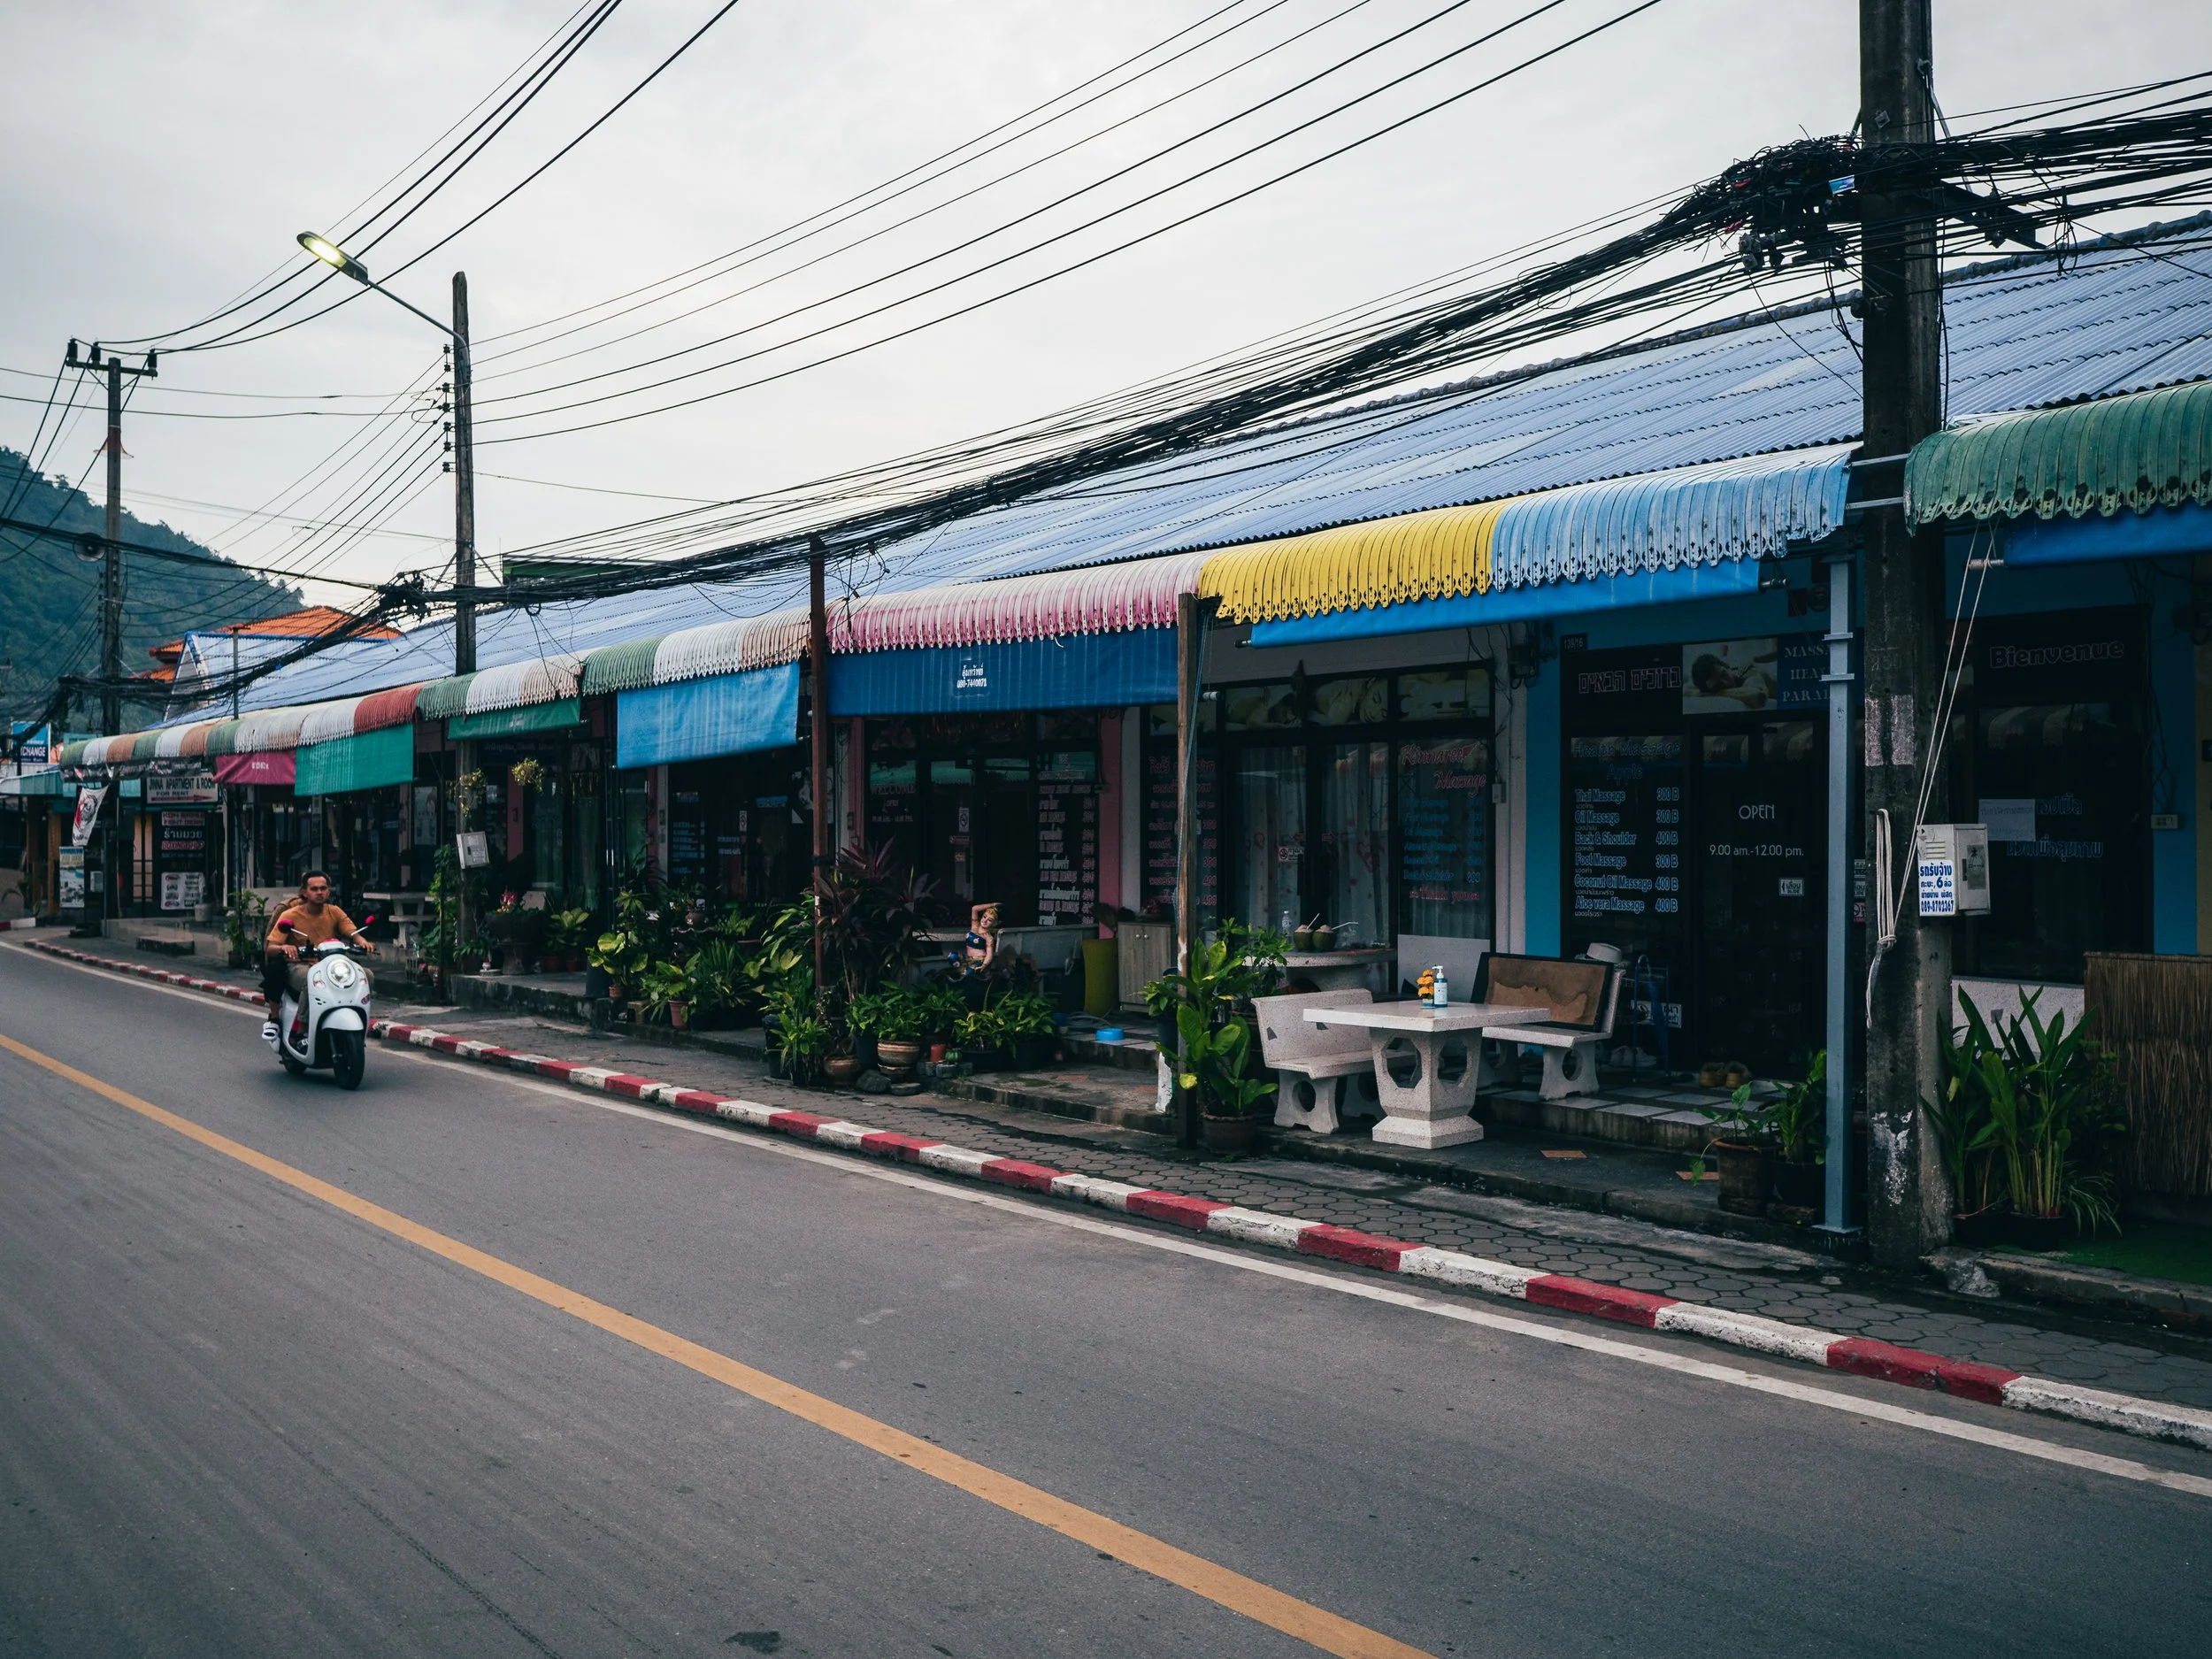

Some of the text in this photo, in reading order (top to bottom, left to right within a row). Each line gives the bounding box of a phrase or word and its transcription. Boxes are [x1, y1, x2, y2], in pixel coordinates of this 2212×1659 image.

[1990, 641, 2124, 669] Bienvenue
[1578, 666, 1681, 694] ברוכים הבאים
[1401, 743, 1466, 766] Kinnaree
[1571, 738, 1684, 759] Health Massage
[1608, 763, 1645, 786] Apple
[150, 778, 163, 790] JINNA
[165, 778, 194, 789] APARTMENT
[196, 778, 202, 789] &
[1435, 771, 1487, 798] Massage
[1575, 788, 1626, 805] Thai Massage
[1655, 787, 1679, 802] 300 B
[1575, 811, 1620, 826] Oil Massage
[1655, 810, 1679, 824] 300 B
[1739, 804, 1775, 819] OPEN
[164, 827, 203, 839] ร้านมวย
[1575, 833, 1637, 846] Back & Shoulder
[1655, 832, 1679, 846] 400 B
[1709, 844, 1732, 856] 9.00
[1786, 846, 1805, 859] pm.
[1575, 853, 1627, 869] Foot Massage
[1655, 854, 1679, 868] 300 B
[1920, 862, 1952, 877] รถรับจ้าง
[1575, 874, 1653, 893] Coconut Oil Massage
[1655, 877, 1679, 891] 400 B
[1936, 877, 1943, 888] 6
[1575, 896, 1646, 915] Aloe vera Massage
[1655, 898, 1679, 912] 400 B
